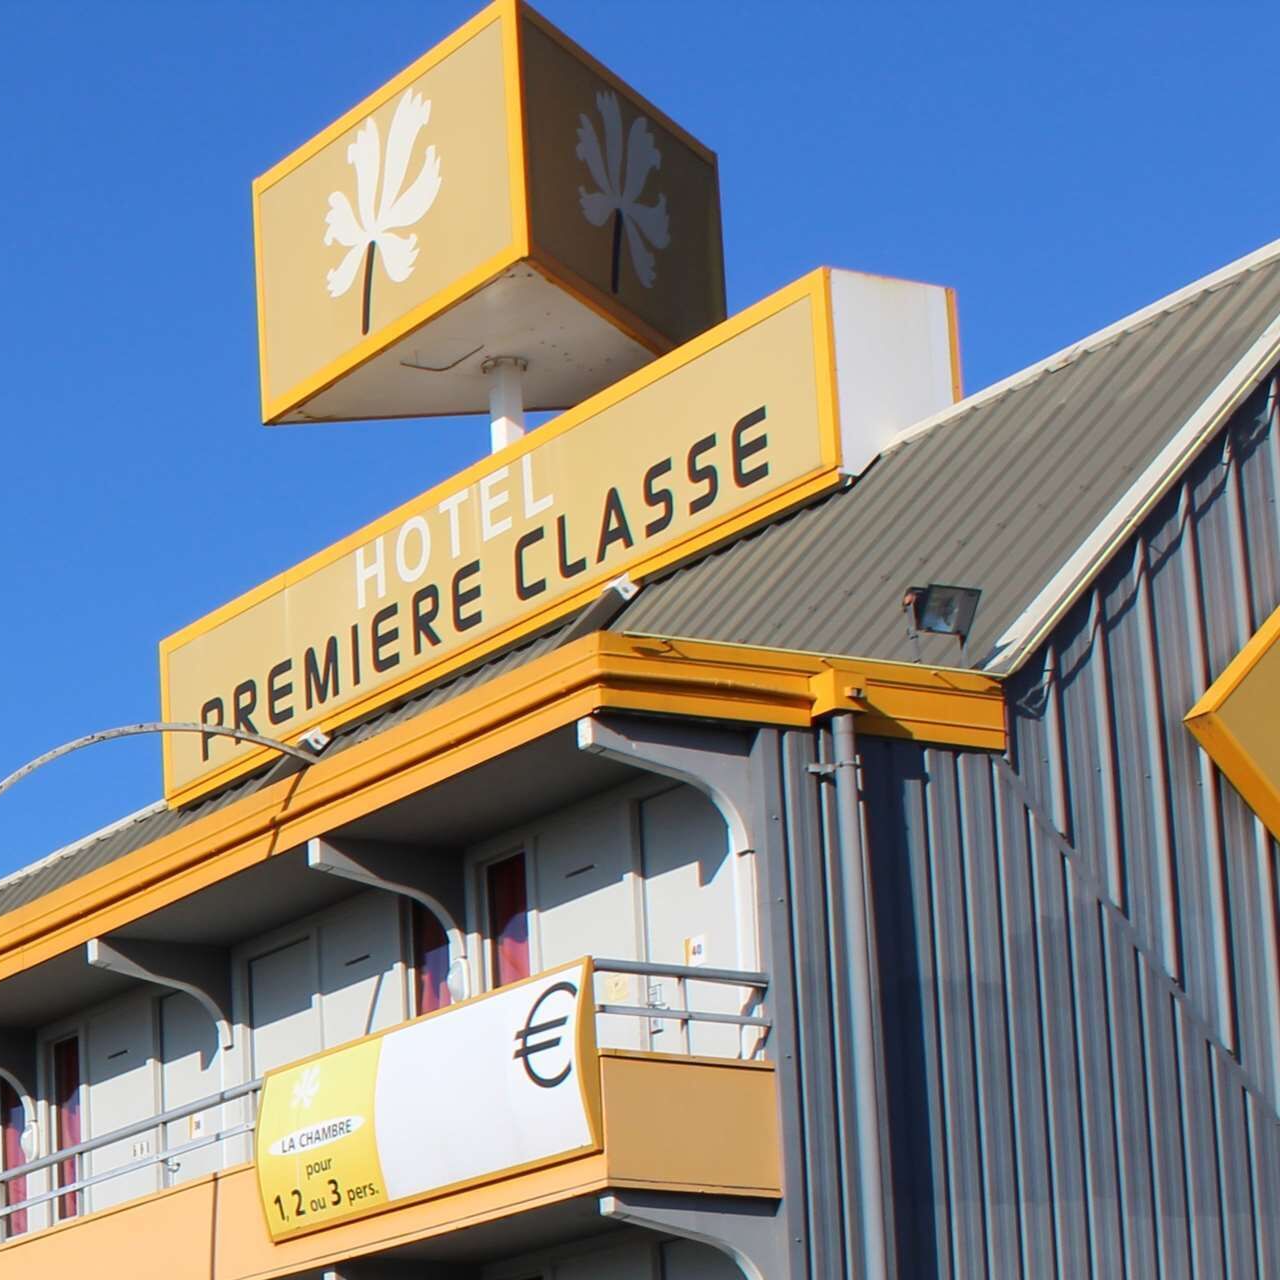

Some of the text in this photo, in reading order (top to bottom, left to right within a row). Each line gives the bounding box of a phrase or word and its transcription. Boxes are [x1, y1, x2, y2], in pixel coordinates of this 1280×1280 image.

[354, 453, 554, 610] HOTEL
[200, 405, 770, 762] PREMIERE CLASSE
[281, 1119, 352, 1154] LA CHAMBRE
[305, 1158, 333, 1180] pour
[291, 1188, 306, 1217] 2
[309, 1197, 327, 1212] ou
[327, 1178, 342, 1207] 3
[346, 1182, 380, 1207] pers.
